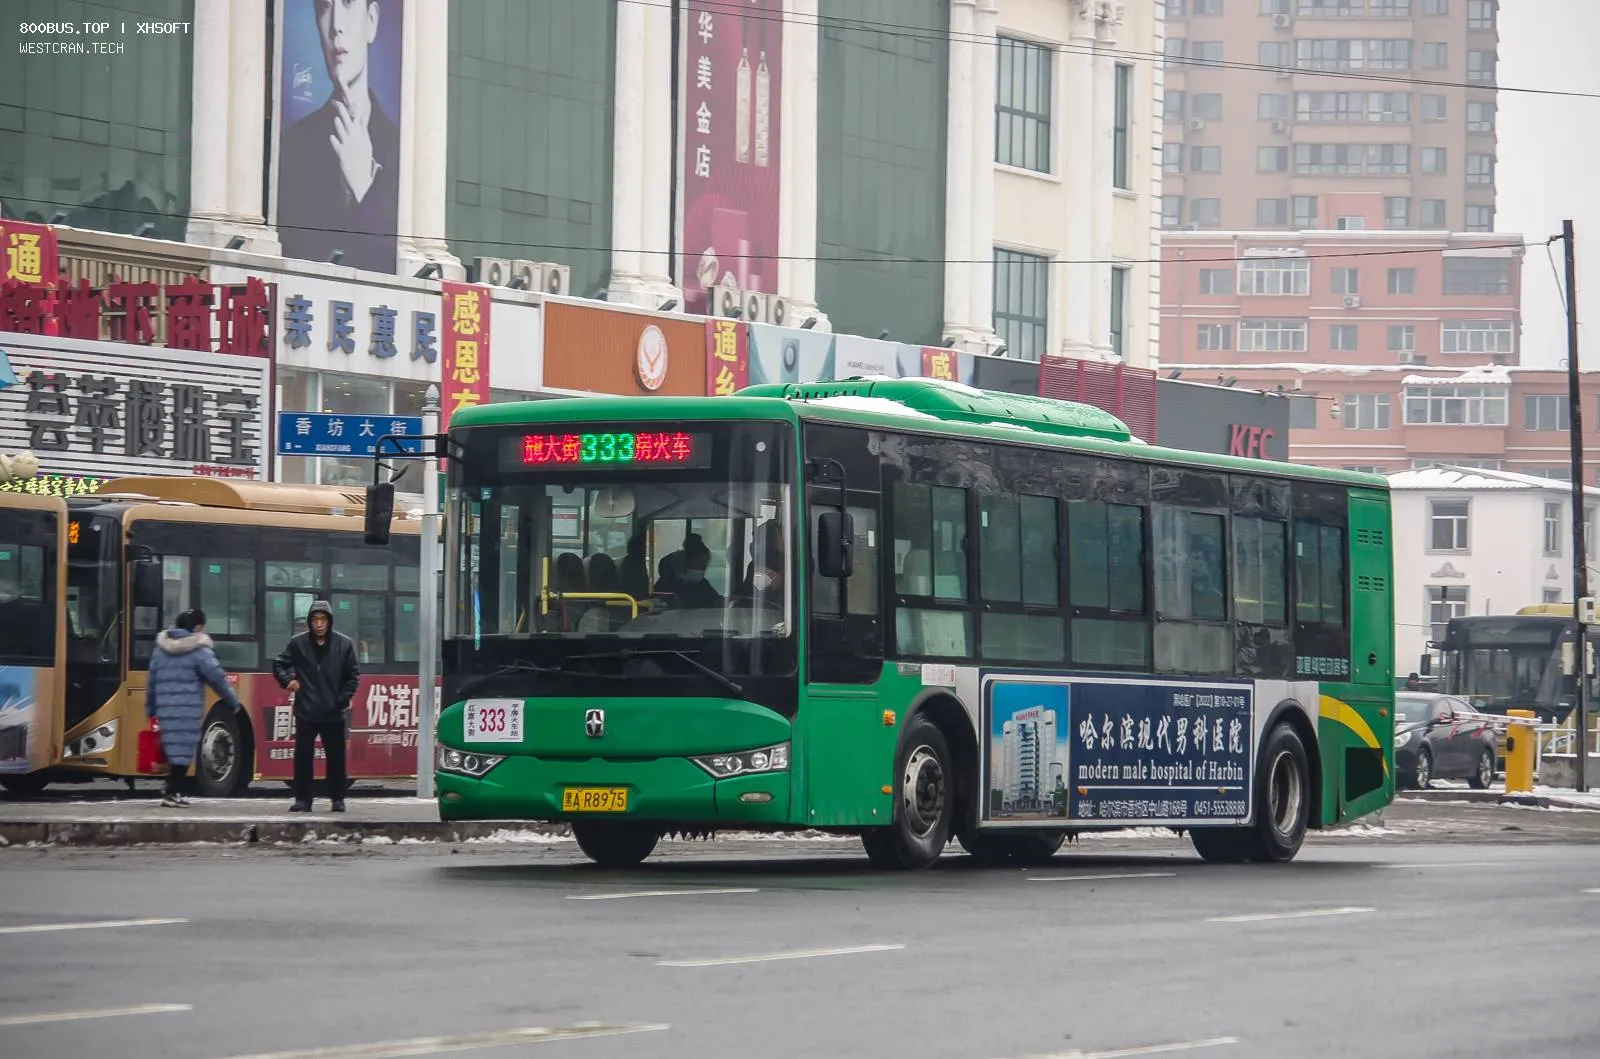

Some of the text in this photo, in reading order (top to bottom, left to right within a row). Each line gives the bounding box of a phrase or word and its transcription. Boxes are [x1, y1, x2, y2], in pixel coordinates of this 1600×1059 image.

[696, 11, 713, 179] 华美金店
[7, 233, 42, 283] 通
[283, 294, 437, 364] 亲民惠民
[25, 370, 258, 464] 荟萃楼珠宝
[295, 417, 407, 437] 香坊大街
[1228, 423, 1275, 459] KFC
[479, 708, 506, 732] 333
[1079, 712, 1244, 756] 哈尔滨现代男科医院
[1078, 758, 1244, 786] modern male hospital of Harbin
